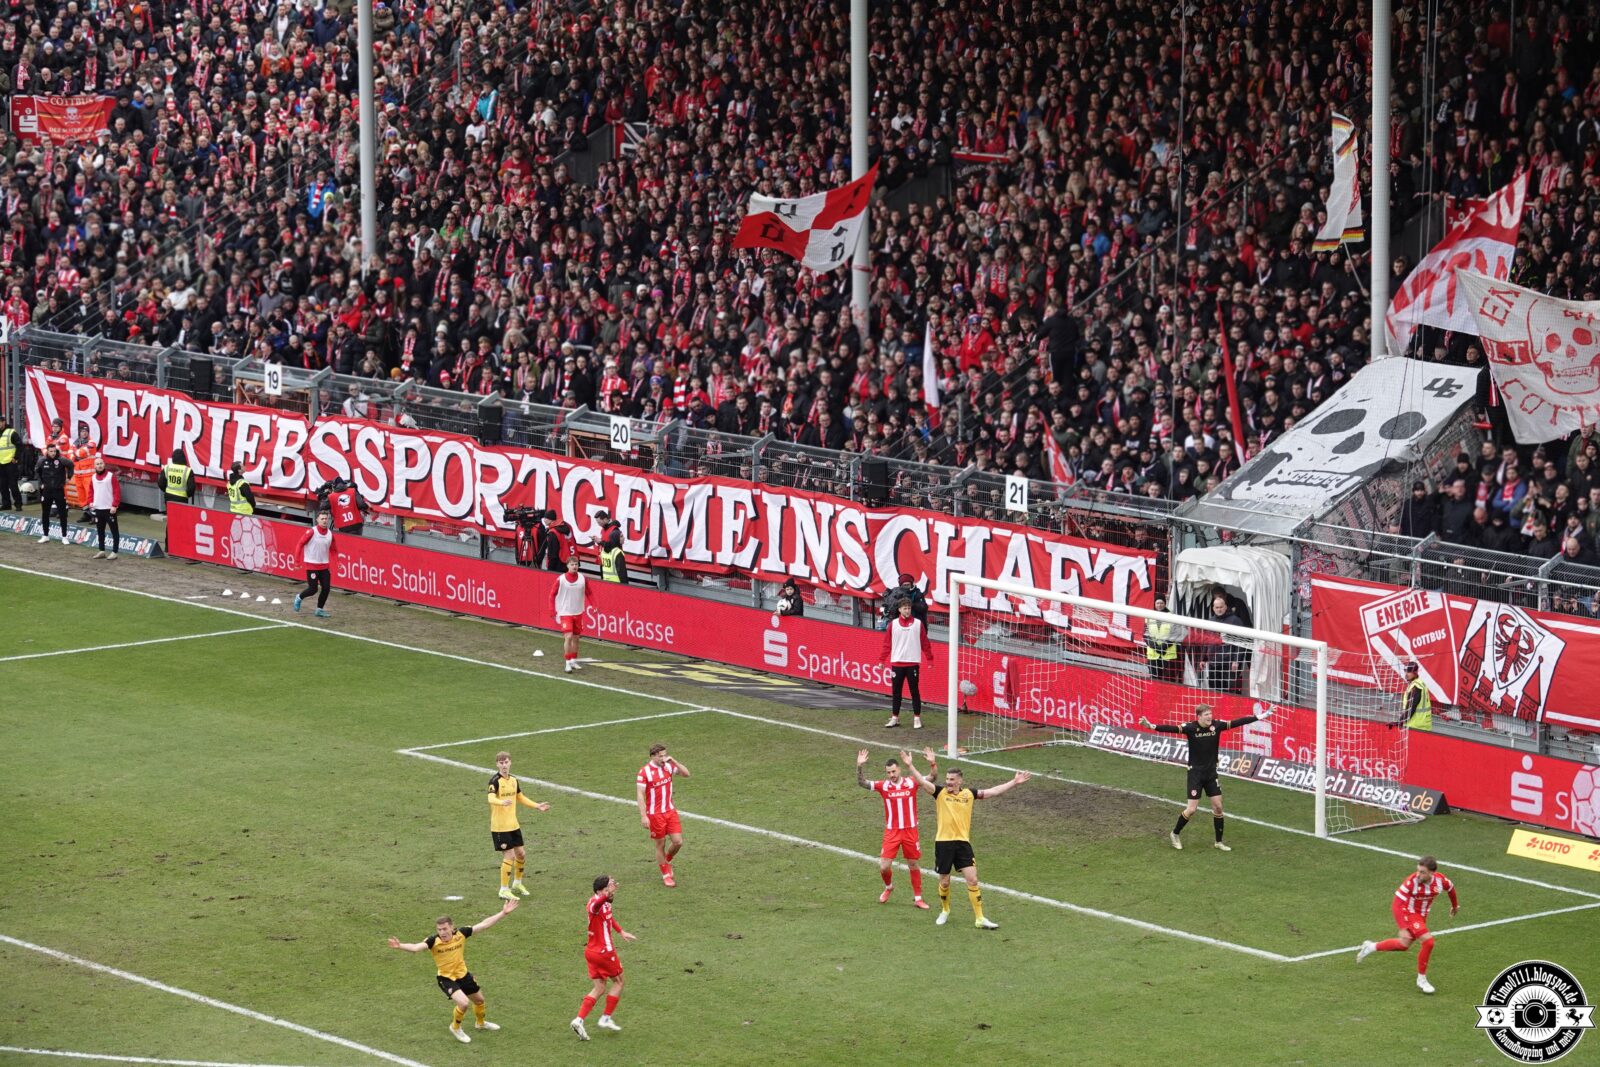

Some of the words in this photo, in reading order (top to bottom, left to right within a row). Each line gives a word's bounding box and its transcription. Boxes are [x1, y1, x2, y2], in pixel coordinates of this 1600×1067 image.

[267, 371, 279, 390] 19
[613, 423, 629, 444] 20
[168, 475, 182, 485] 108
[1010, 482, 1024, 505] 21
[66, 380, 1150, 641] BETRIEBSSPORTGEMEINSCHAFT
[341, 512, 354, 522] 10
[337, 553, 387, 586] Sicher.
[391, 564, 441, 597] Stabil.
[445, 574, 501, 608] Solide.
[586, 605, 675, 644] Sparkasse
[1412, 628, 1447, 649] COTTBUS
[797, 645, 893, 687] Sparkasse
[1030, 687, 1134, 729] Sparkasse
[1088, 725, 1171, 758] Eisenbach
[1258, 759, 1347, 793] Eisenbch
[1349, 775, 1434, 811] Tresore.de
[1540, 839, 1571, 855] LOTTO
